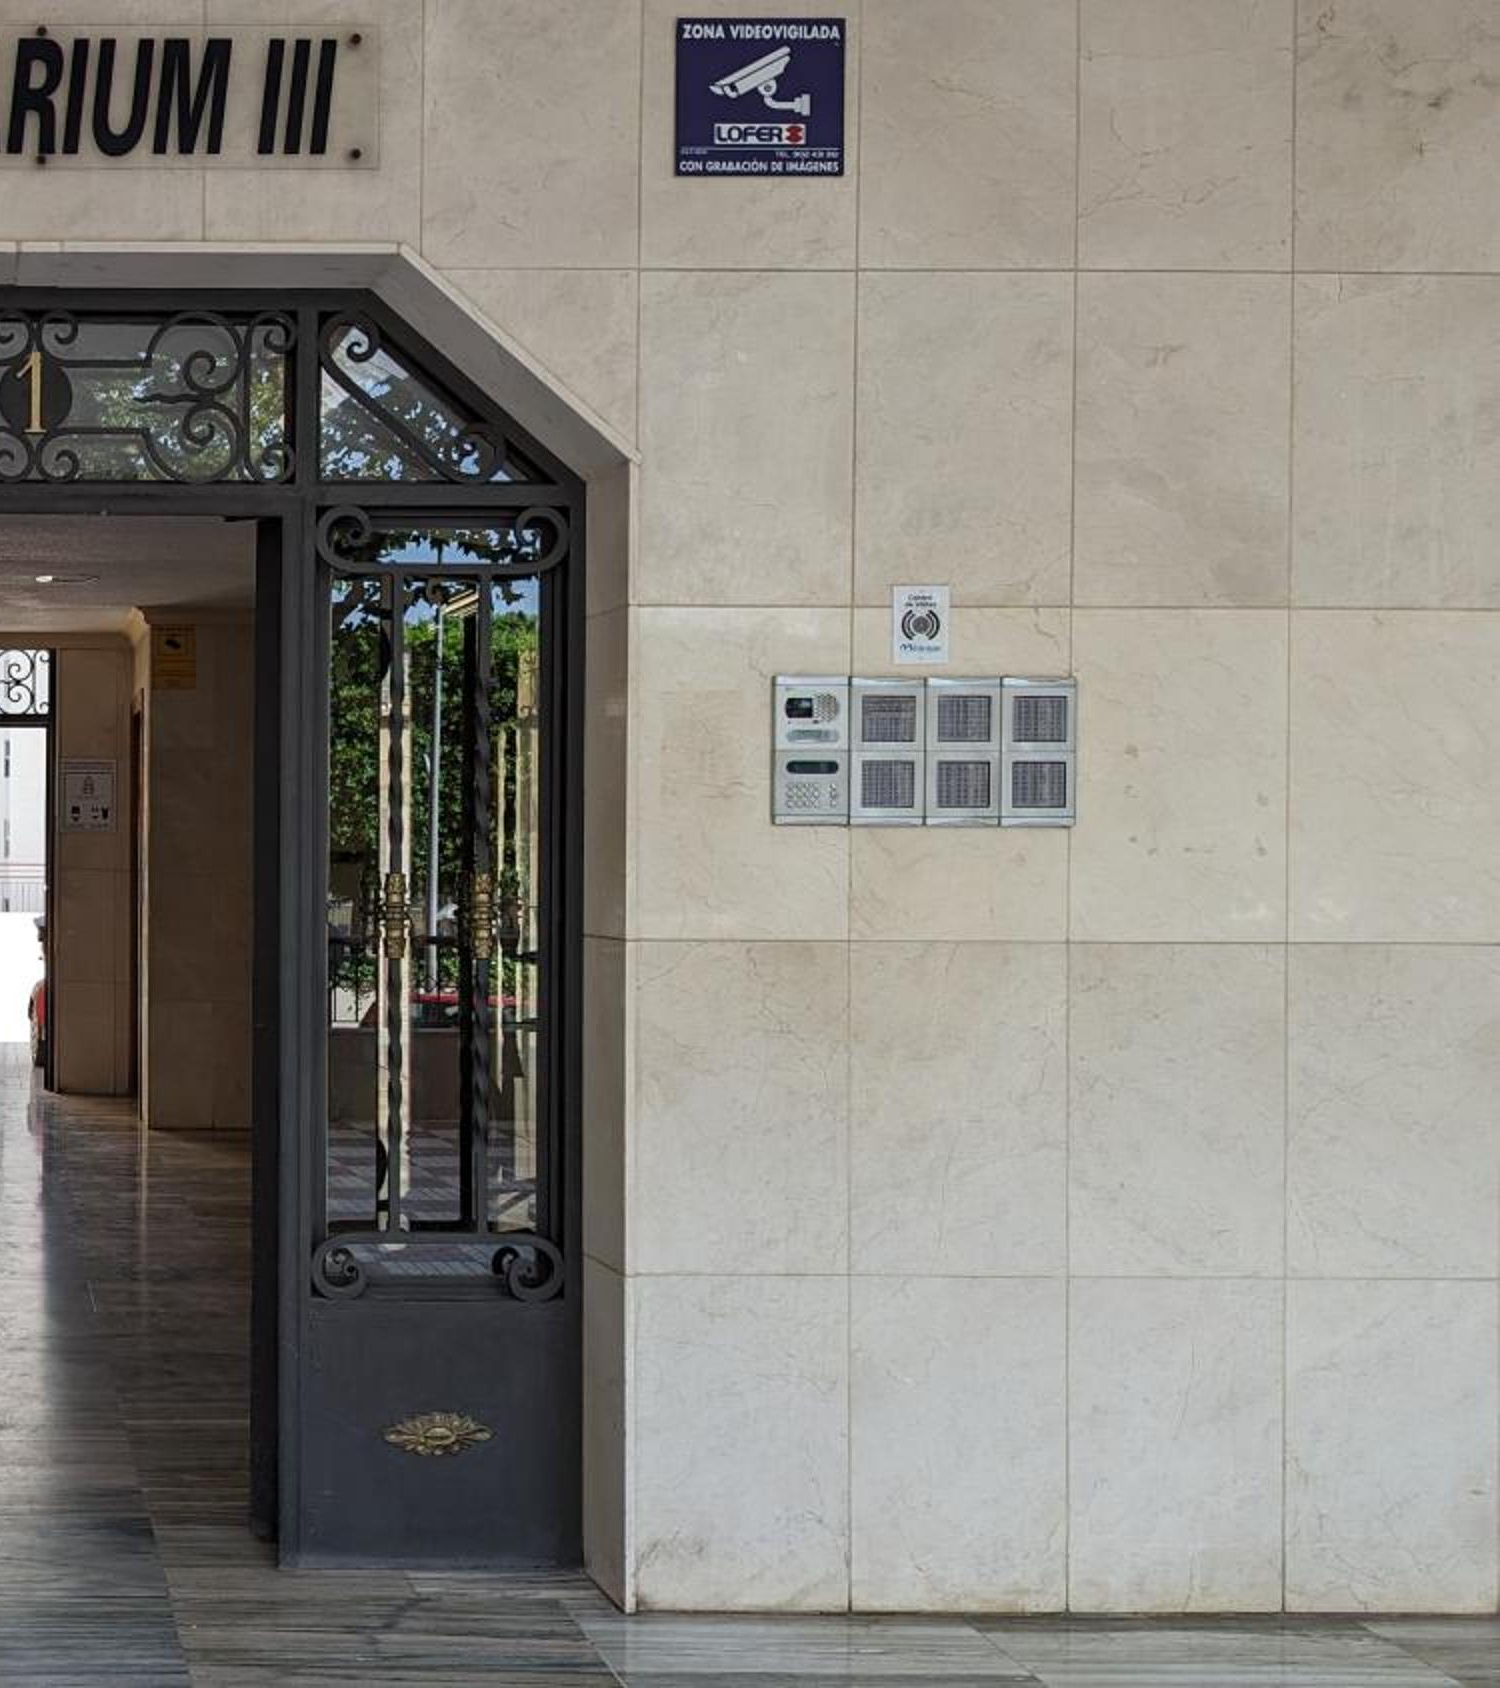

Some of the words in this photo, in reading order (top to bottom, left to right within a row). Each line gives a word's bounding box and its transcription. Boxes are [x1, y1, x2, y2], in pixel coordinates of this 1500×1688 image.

[682, 24, 725, 39] ZONA
[729, 24, 840, 39] VIDEOVIGILADA
[257, 38, 338, 156] III
[717, 126, 783, 142] LOFER
[680, 160, 703, 172] CON
[706, 157, 769, 172] GRABACIÓN
[771, 160, 783, 172] DE
[786, 157, 839, 172] IMÁGENES
[15, 351, 47, 433] 1
